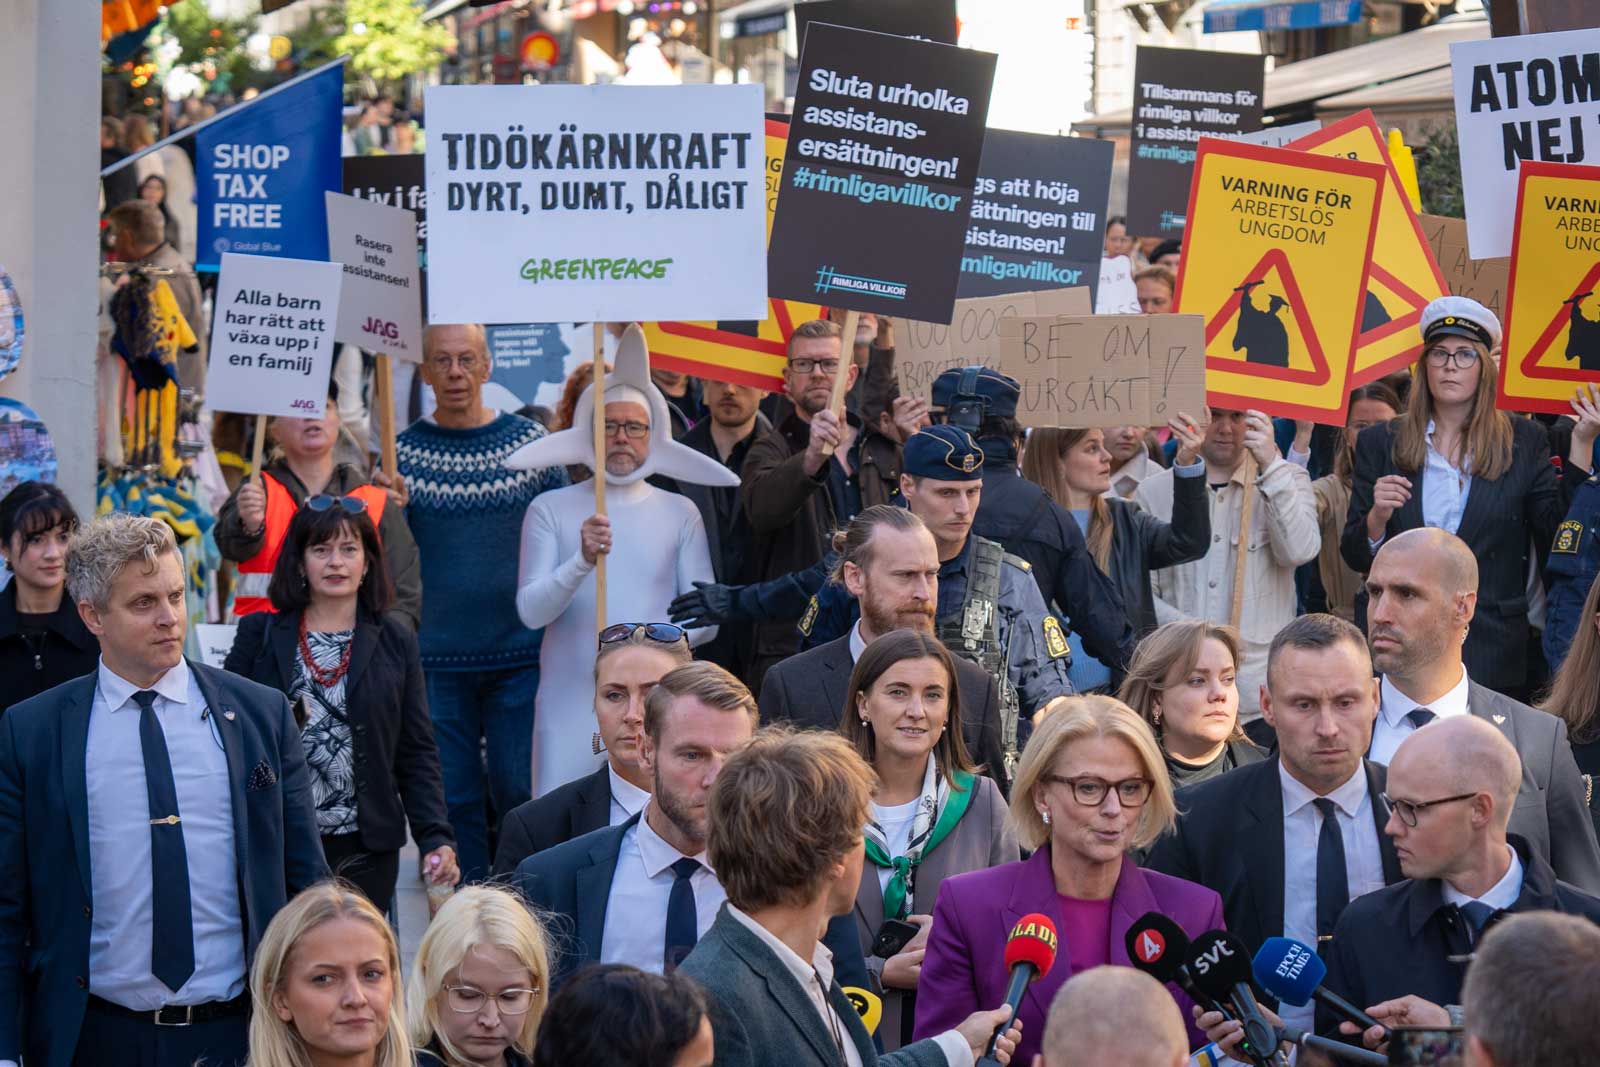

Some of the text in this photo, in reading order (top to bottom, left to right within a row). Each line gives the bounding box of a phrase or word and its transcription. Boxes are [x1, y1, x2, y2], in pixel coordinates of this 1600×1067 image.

[809, 68, 969, 115] Sluta urholka
[1140, 83, 1258, 106] Tillsammans för
[1471, 53, 1600, 113] ATOM
[803, 106, 926, 139] assistans-
[1139, 104, 1240, 125] rimliga villkor
[213, 143, 290, 169] SHOP
[441, 123, 751, 171] TIDÖKÄRNKRAFT
[1502, 115, 1585, 171] NEJ
[798, 138, 959, 179] ersättningen!
[213, 173, 268, 199] TAX
[447, 181, 530, 215] DYRT,
[540, 181, 634, 215] DUMT,
[645, 173, 748, 210] DÅLIGT
[793, 166, 961, 212] #rimligavillkor
[1000, 178, 1031, 197] att
[1034, 180, 1079, 205] höja
[1221, 175, 1352, 210] VARNING FÖR
[213, 203, 282, 228] FREE
[970, 199, 1096, 231] ättningen till
[1231, 198, 1335, 227] ARBETSLÖS
[1544, 195, 1600, 214] VARN
[355, 234, 393, 254] Rasera
[1239, 218, 1327, 246] UNGDOM
[234, 241, 282, 251] Global Blue
[364, 251, 386, 267] inte
[343, 262, 409, 288] assistansen!
[520, 257, 673, 284] GREENPEACE
[234, 289, 321, 310] Alla barn
[869, 283, 907, 295] VILLKOR
[225, 310, 326, 332] har rätt att
[362, 316, 399, 339] JAG
[228, 329, 319, 352] växa upp i
[1023, 322, 1151, 364] BE OM
[229, 353, 313, 376] en familj
[290, 399, 315, 409] JAG
[1143, 930, 1161, 960] 4
[1195, 938, 1235, 975] svt
[1275, 943, 1302, 977] EPOCH
[1287, 950, 1311, 980] TIMES
